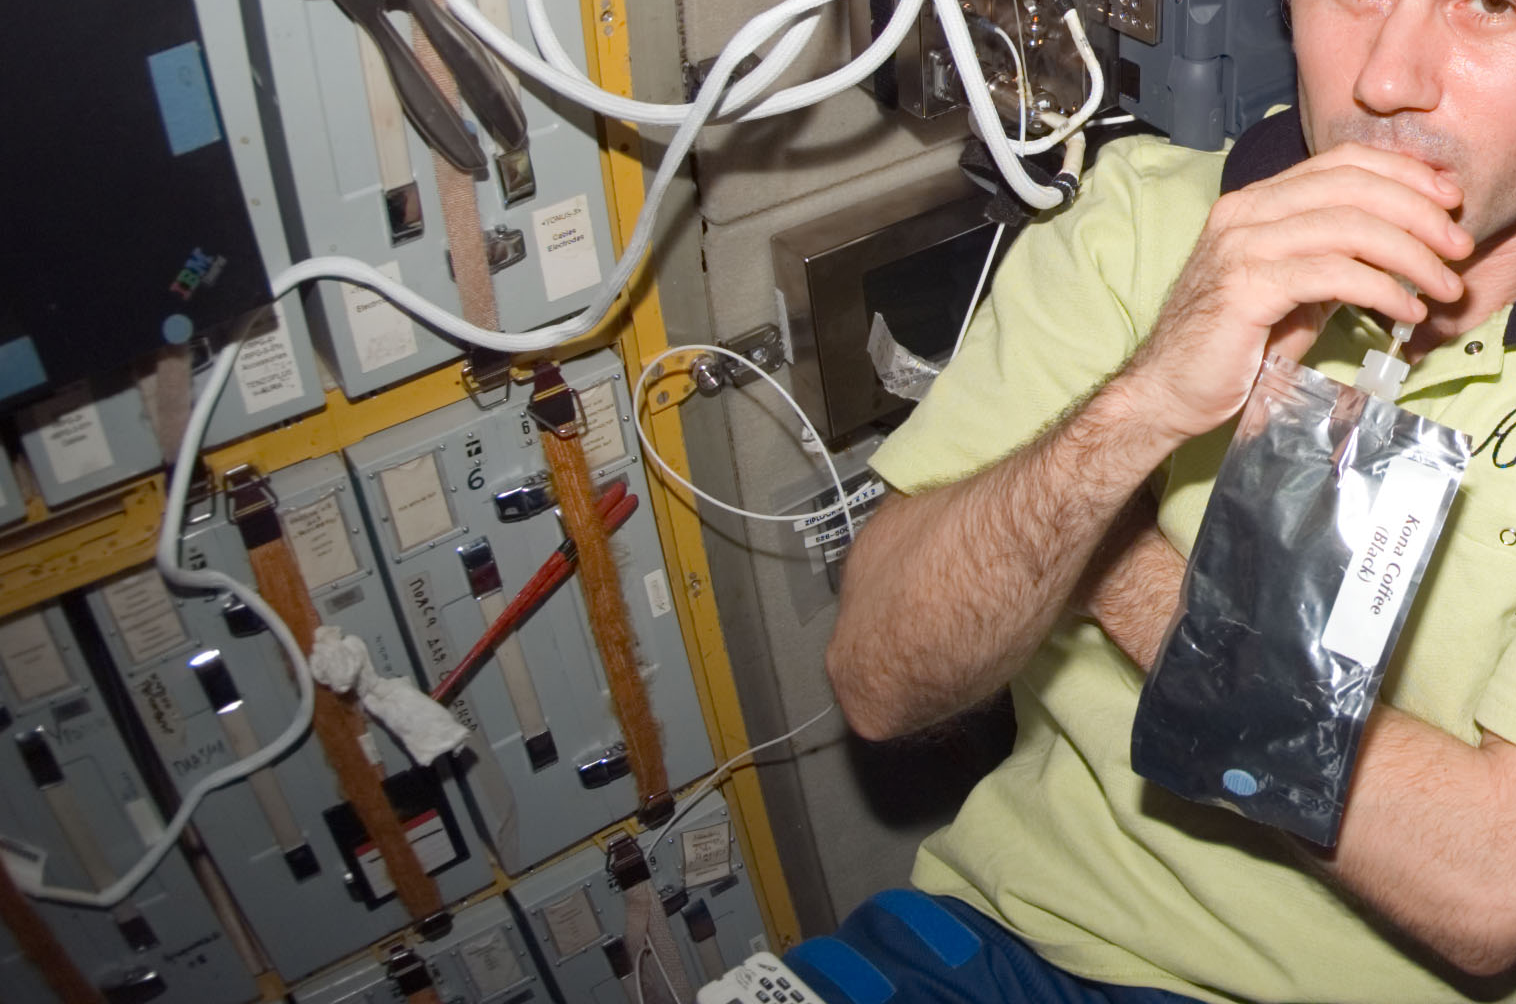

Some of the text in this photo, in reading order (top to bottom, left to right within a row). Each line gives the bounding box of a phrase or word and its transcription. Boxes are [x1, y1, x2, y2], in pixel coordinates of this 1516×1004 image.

[547, 234, 584, 252] Electrodes
[170, 246, 214, 300] IBM
[468, 468, 485, 490] 6
[1357, 525, 1389, 583] (Black)
[1370, 514, 1421, 615] Kona Coffee
